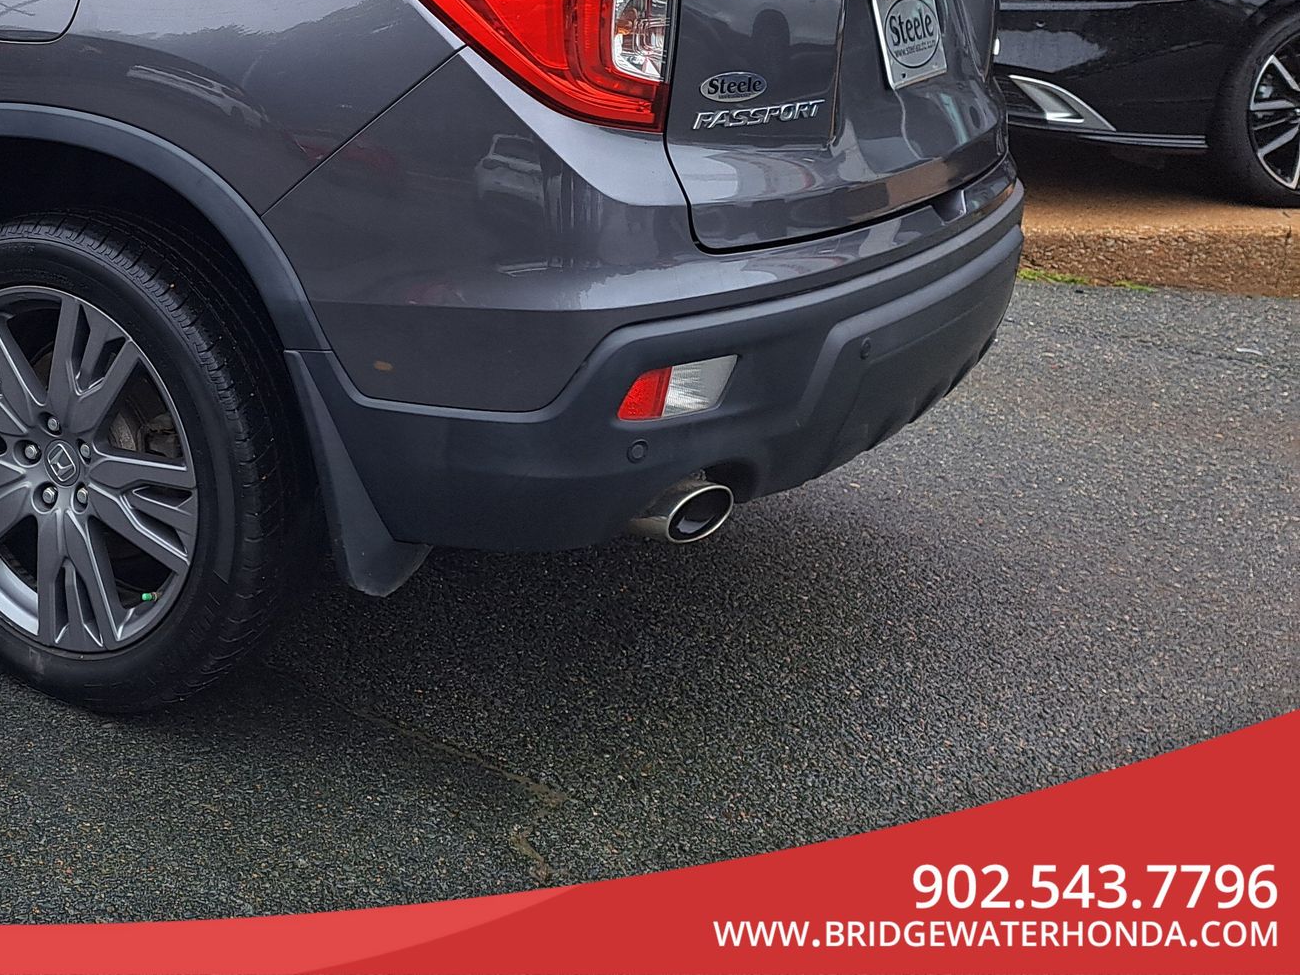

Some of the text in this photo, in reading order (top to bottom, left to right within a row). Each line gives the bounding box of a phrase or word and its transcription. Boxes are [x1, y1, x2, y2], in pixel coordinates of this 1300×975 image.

[889, 9, 934, 46] Steele
[707, 77, 762, 95] Steele
[692, 99, 825, 130] PASSPORT
